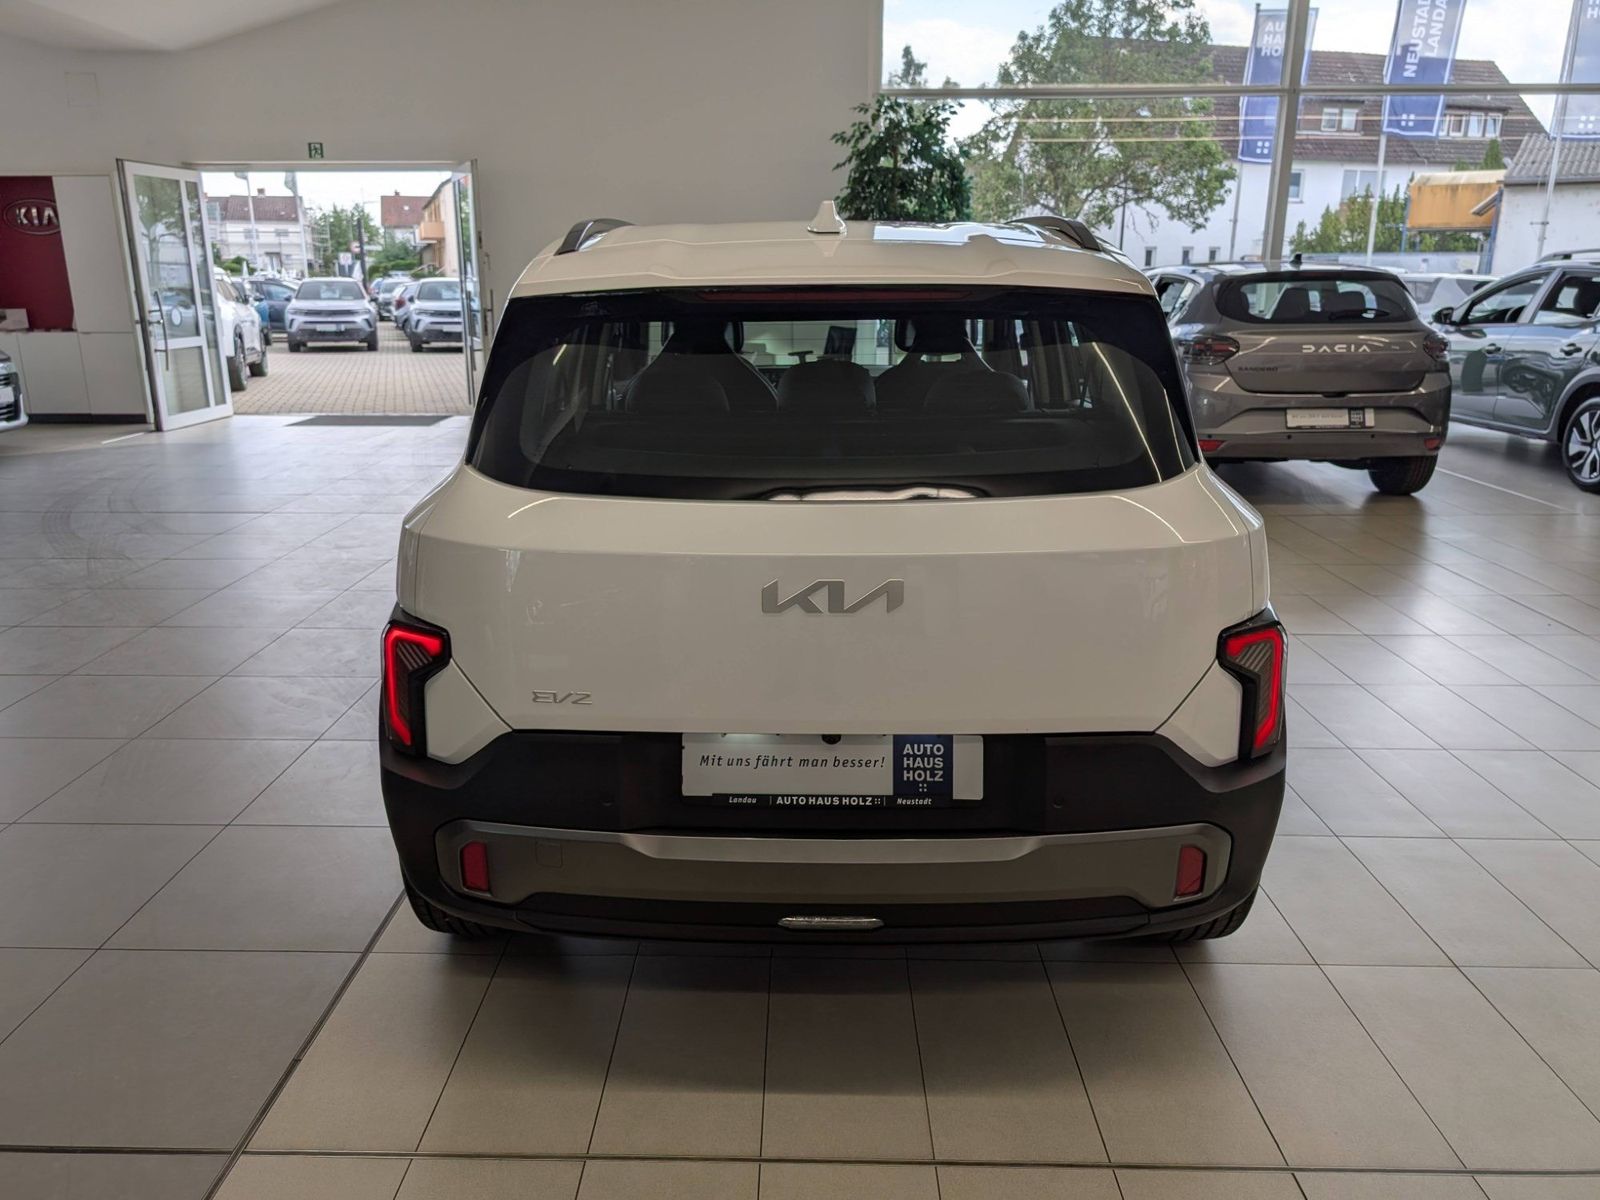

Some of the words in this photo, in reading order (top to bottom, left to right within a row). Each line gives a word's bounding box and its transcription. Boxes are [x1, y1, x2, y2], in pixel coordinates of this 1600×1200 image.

[1265, 21, 1285, 33] AU
[1262, 33, 1283, 45] HA
[1261, 46, 1282, 57] HO
[16, 206, 59, 226] KIA
[1302, 344, 1370, 353] DACIA
[761, 578, 905, 614] KIA
[532, 689, 593, 705] EV2
[903, 743, 944, 755] AUTO
[700, 754, 723, 767] Mit
[726, 757, 751, 767] uns
[753, 754, 794, 770] fährt
[799, 757, 829, 768] man
[832, 756, 886, 768] besser!
[903, 757, 944, 768] HAUS
[903, 770, 944, 781] HOLZ
[728, 796, 757, 804] Landau
[842, 796, 873, 806] HOLZ
[896, 797, 932, 806] Neustadt
